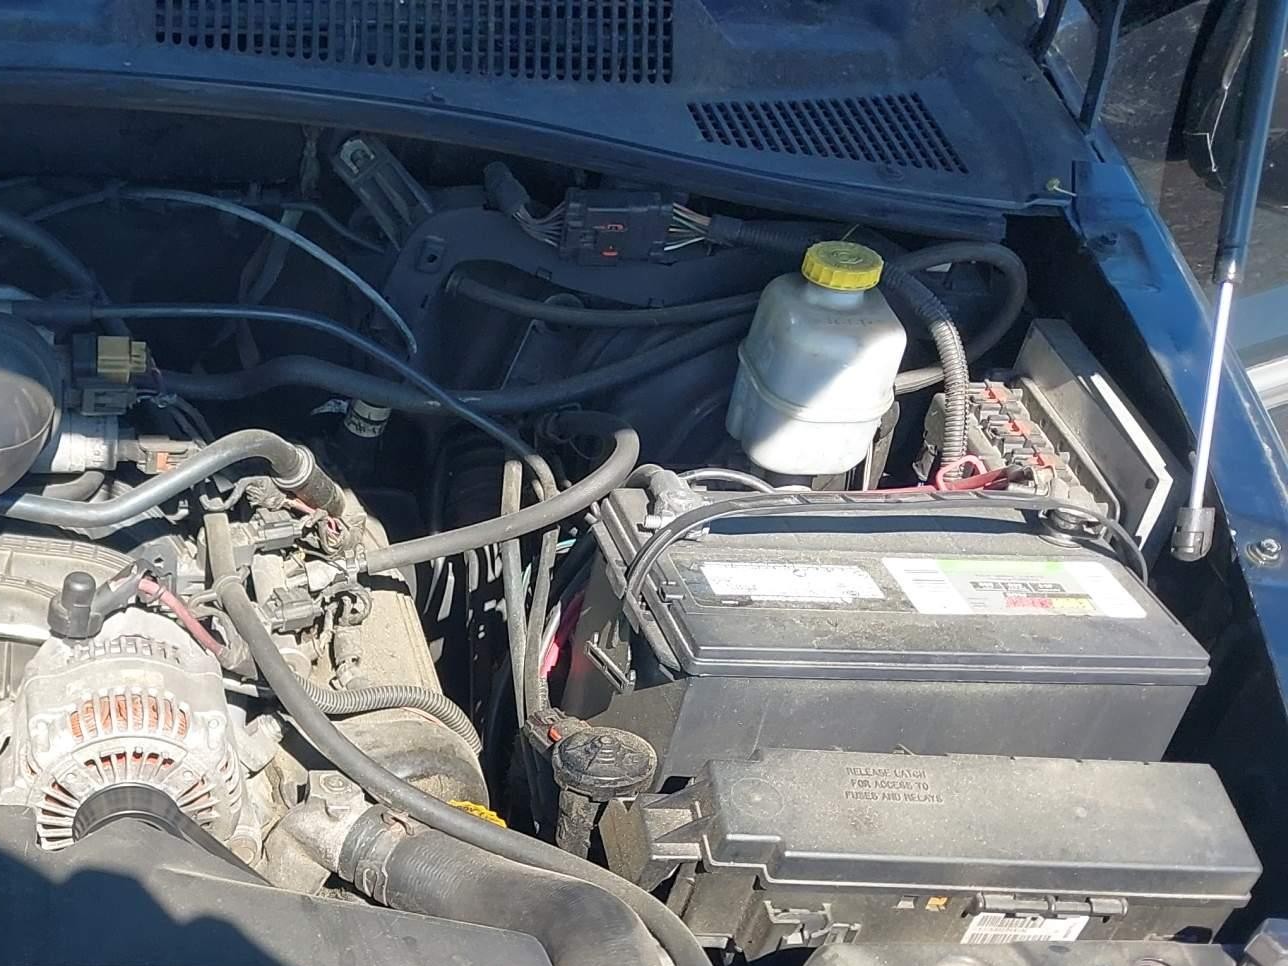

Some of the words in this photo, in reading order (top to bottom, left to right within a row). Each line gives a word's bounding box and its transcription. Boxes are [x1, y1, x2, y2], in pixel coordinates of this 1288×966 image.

[846, 767, 891, 778] RELEASE
[893, 768, 926, 779] LATCH
[850, 779, 872, 788] FOR
[874, 780, 913, 789] ACCESS
[914, 782, 929, 791] TO
[845, 791, 879, 801] FUSES
[882, 792, 901, 801] AND
[903, 793, 944, 803] RELAYS
